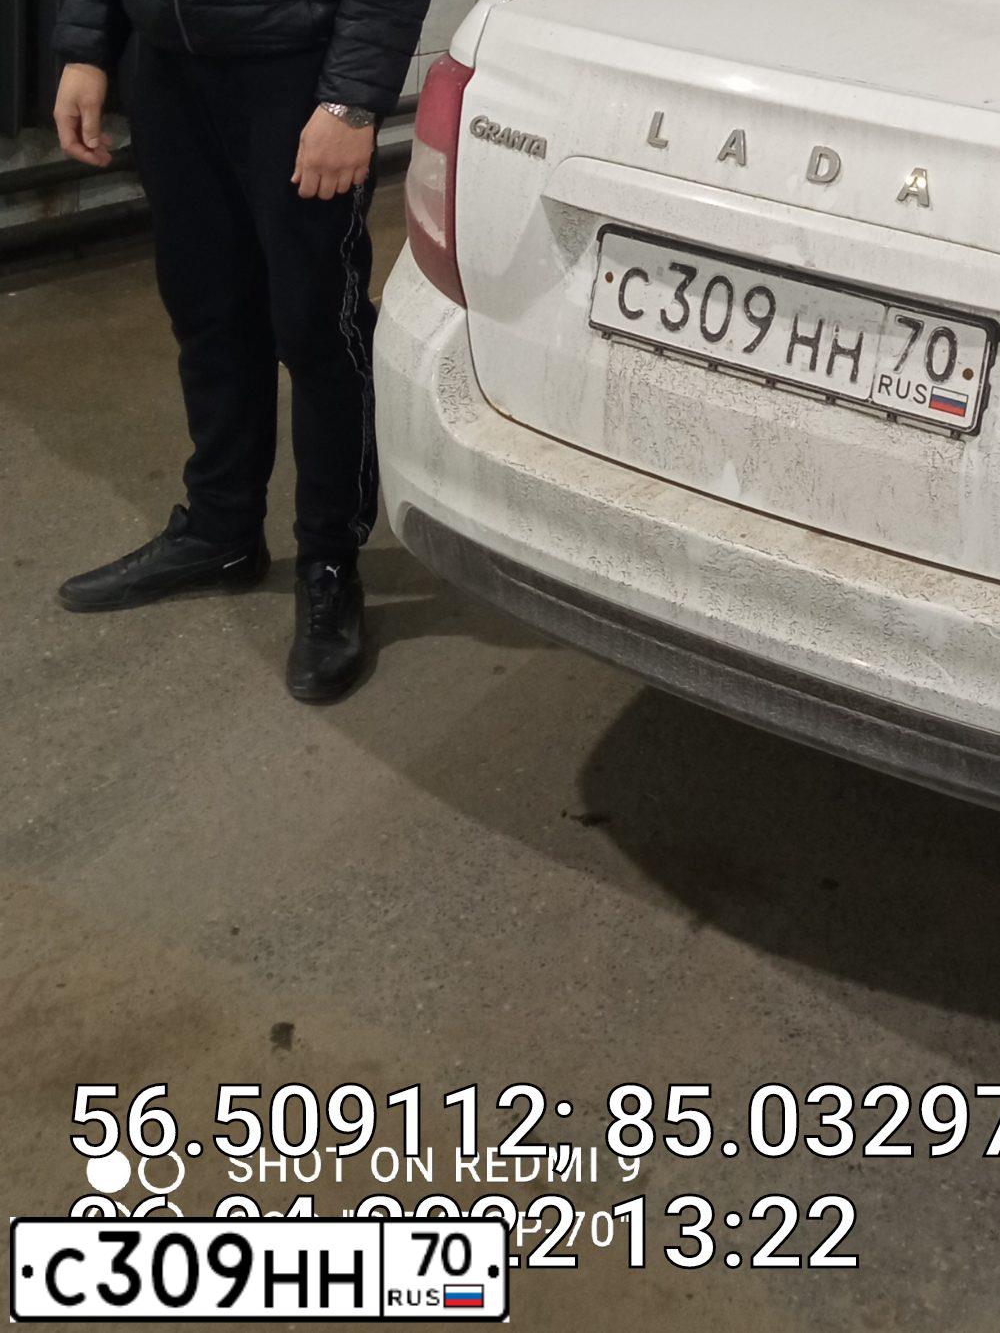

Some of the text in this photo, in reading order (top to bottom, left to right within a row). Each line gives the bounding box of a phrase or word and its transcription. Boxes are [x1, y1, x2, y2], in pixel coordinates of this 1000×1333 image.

[469, 114, 548, 160] GRANTA
[645, 110, 932, 209] LADA
[893, 314, 959, 383] 70
[877, 373, 928, 406] RUS
